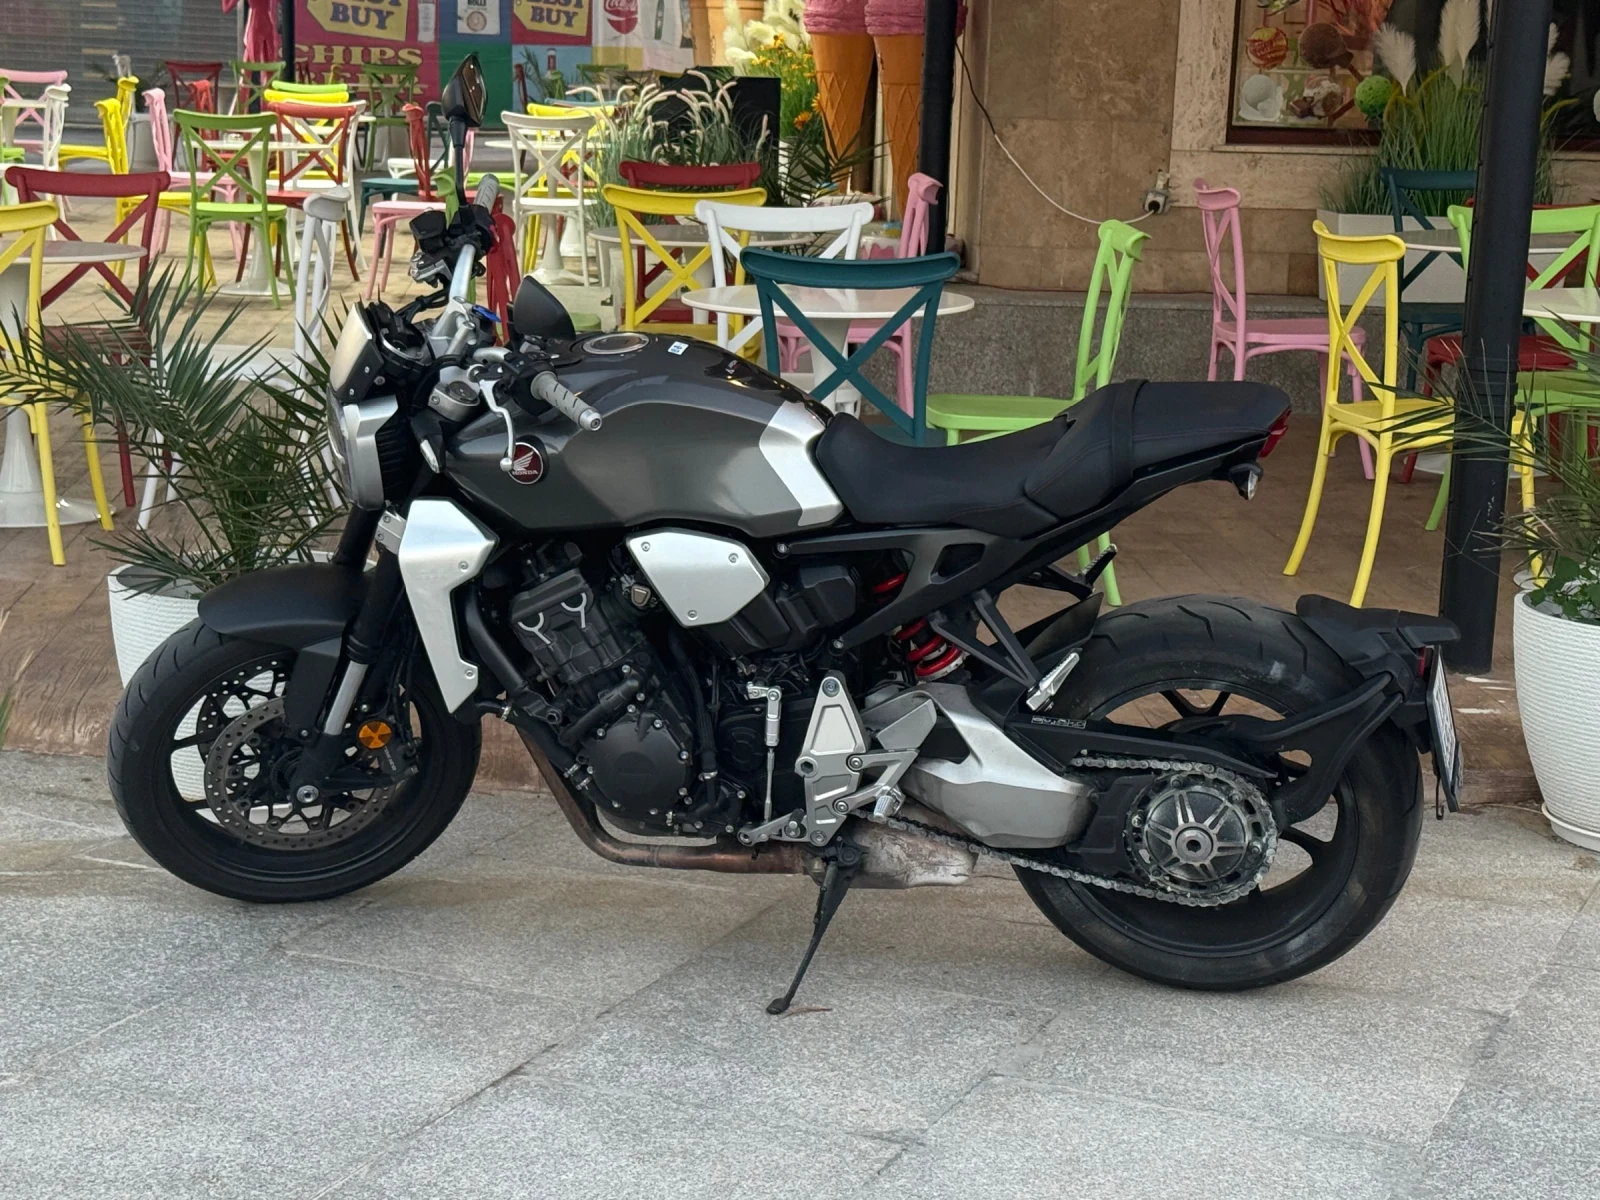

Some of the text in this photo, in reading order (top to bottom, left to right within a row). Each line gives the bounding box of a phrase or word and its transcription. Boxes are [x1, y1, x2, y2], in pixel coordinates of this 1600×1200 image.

[330, 2, 394, 30] BUY
[530, 6, 579, 28] BUY
[279, 43, 423, 66] CHIPS
